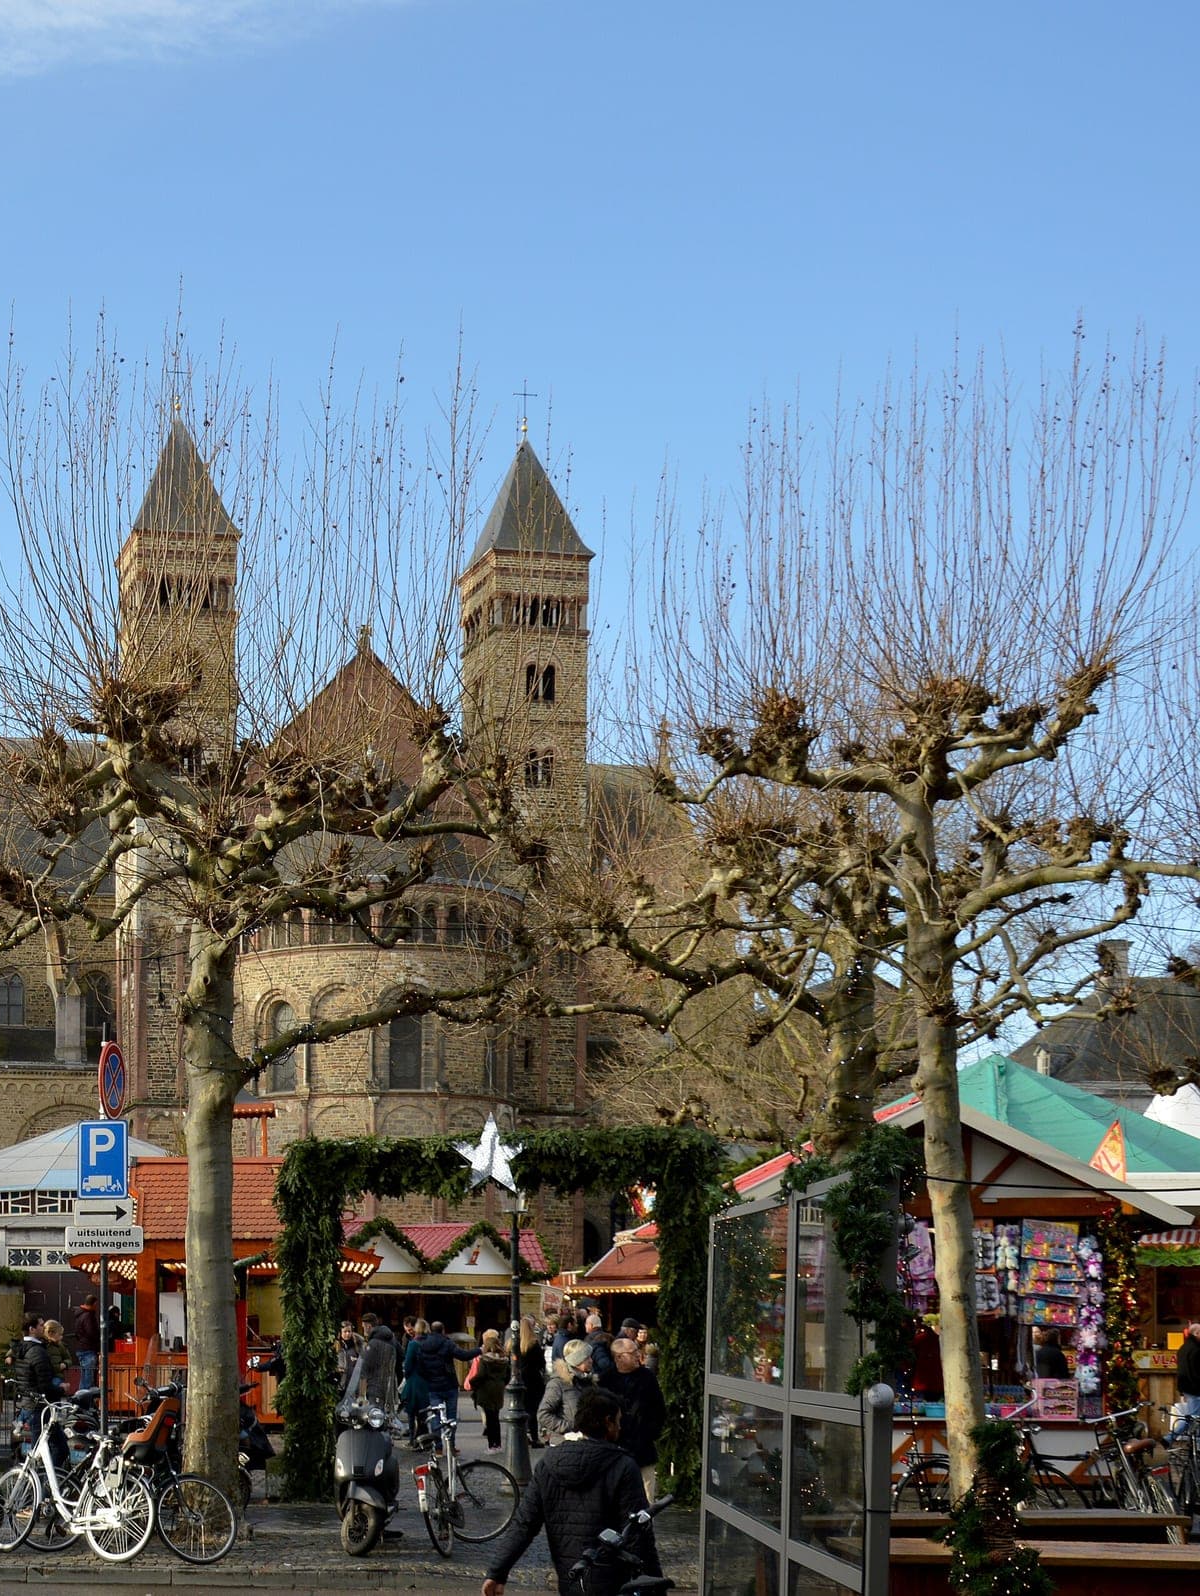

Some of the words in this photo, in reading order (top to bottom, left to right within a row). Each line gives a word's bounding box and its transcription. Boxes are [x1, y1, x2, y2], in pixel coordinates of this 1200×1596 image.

[89, 1128, 115, 1166] P
[77, 1228, 132, 1237] uitsluitend
[68, 1240, 141, 1249] vrachtwagens
